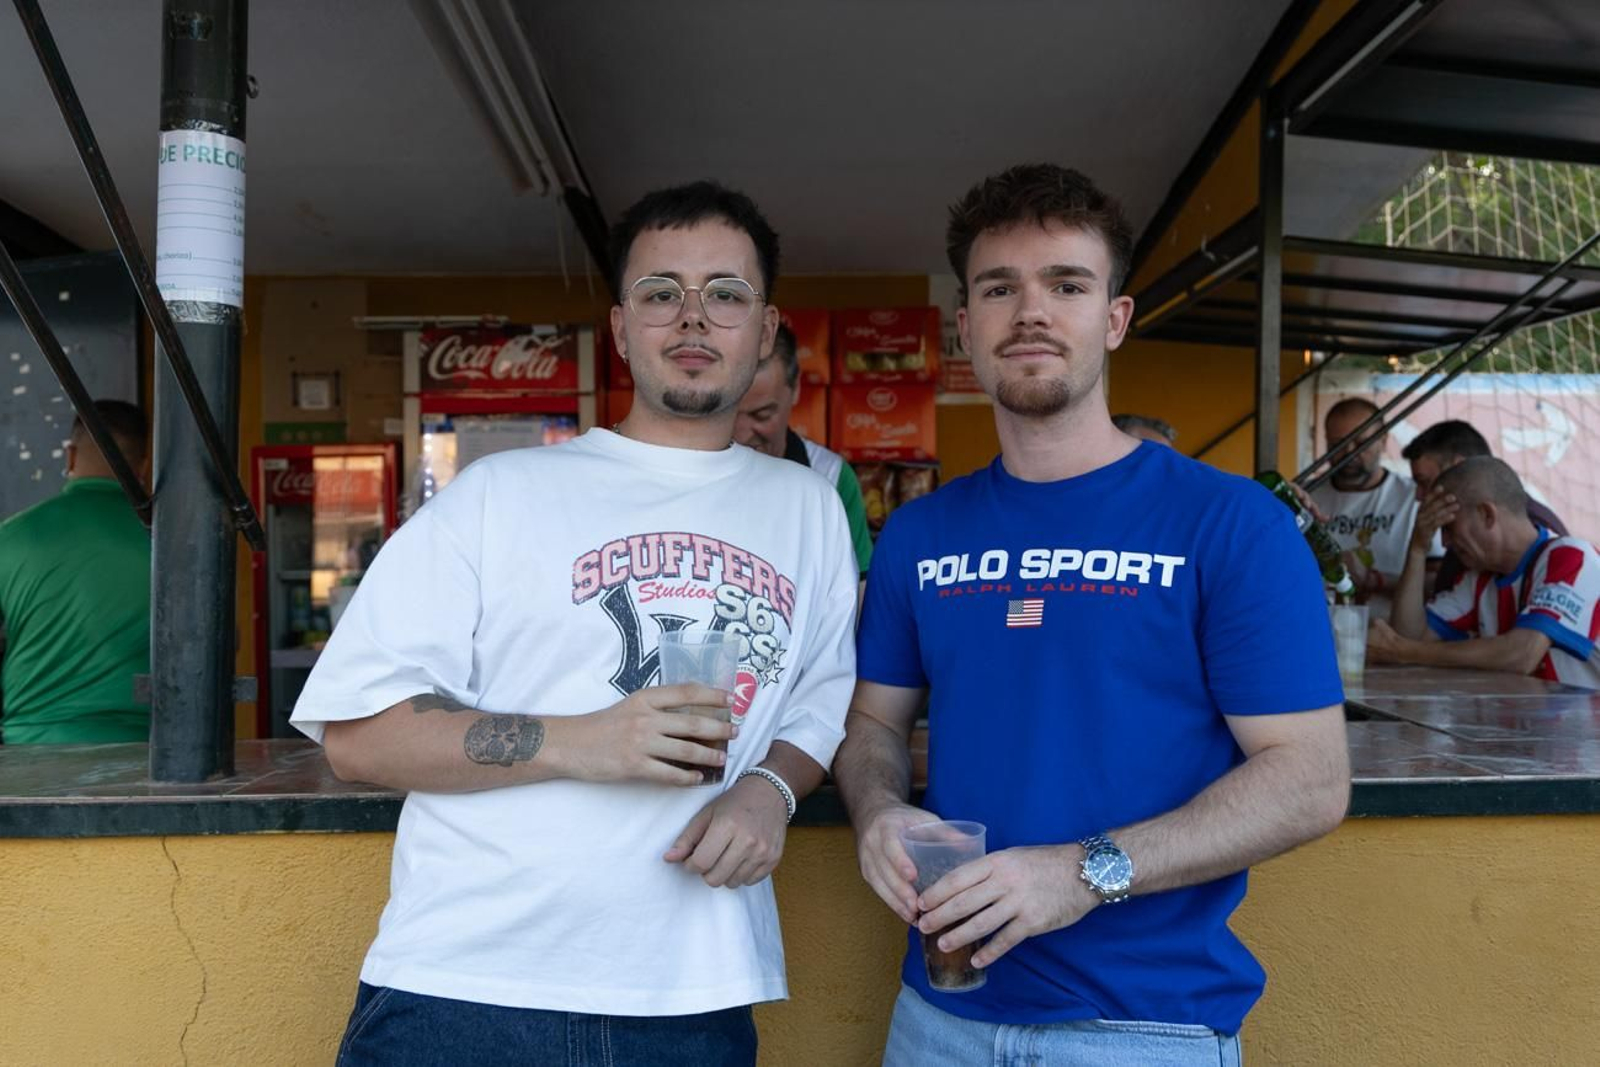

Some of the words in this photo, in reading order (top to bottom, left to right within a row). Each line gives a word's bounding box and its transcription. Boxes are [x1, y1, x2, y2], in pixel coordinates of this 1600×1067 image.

[571, 531, 797, 634] SCUFFERS
[917, 549, 1009, 591] POLO
[1019, 548, 1186, 588] SPORT
[638, 581, 717, 603] Studios
[939, 583, 1012, 598] RALPH
[1026, 582, 1138, 596] LAUREN
